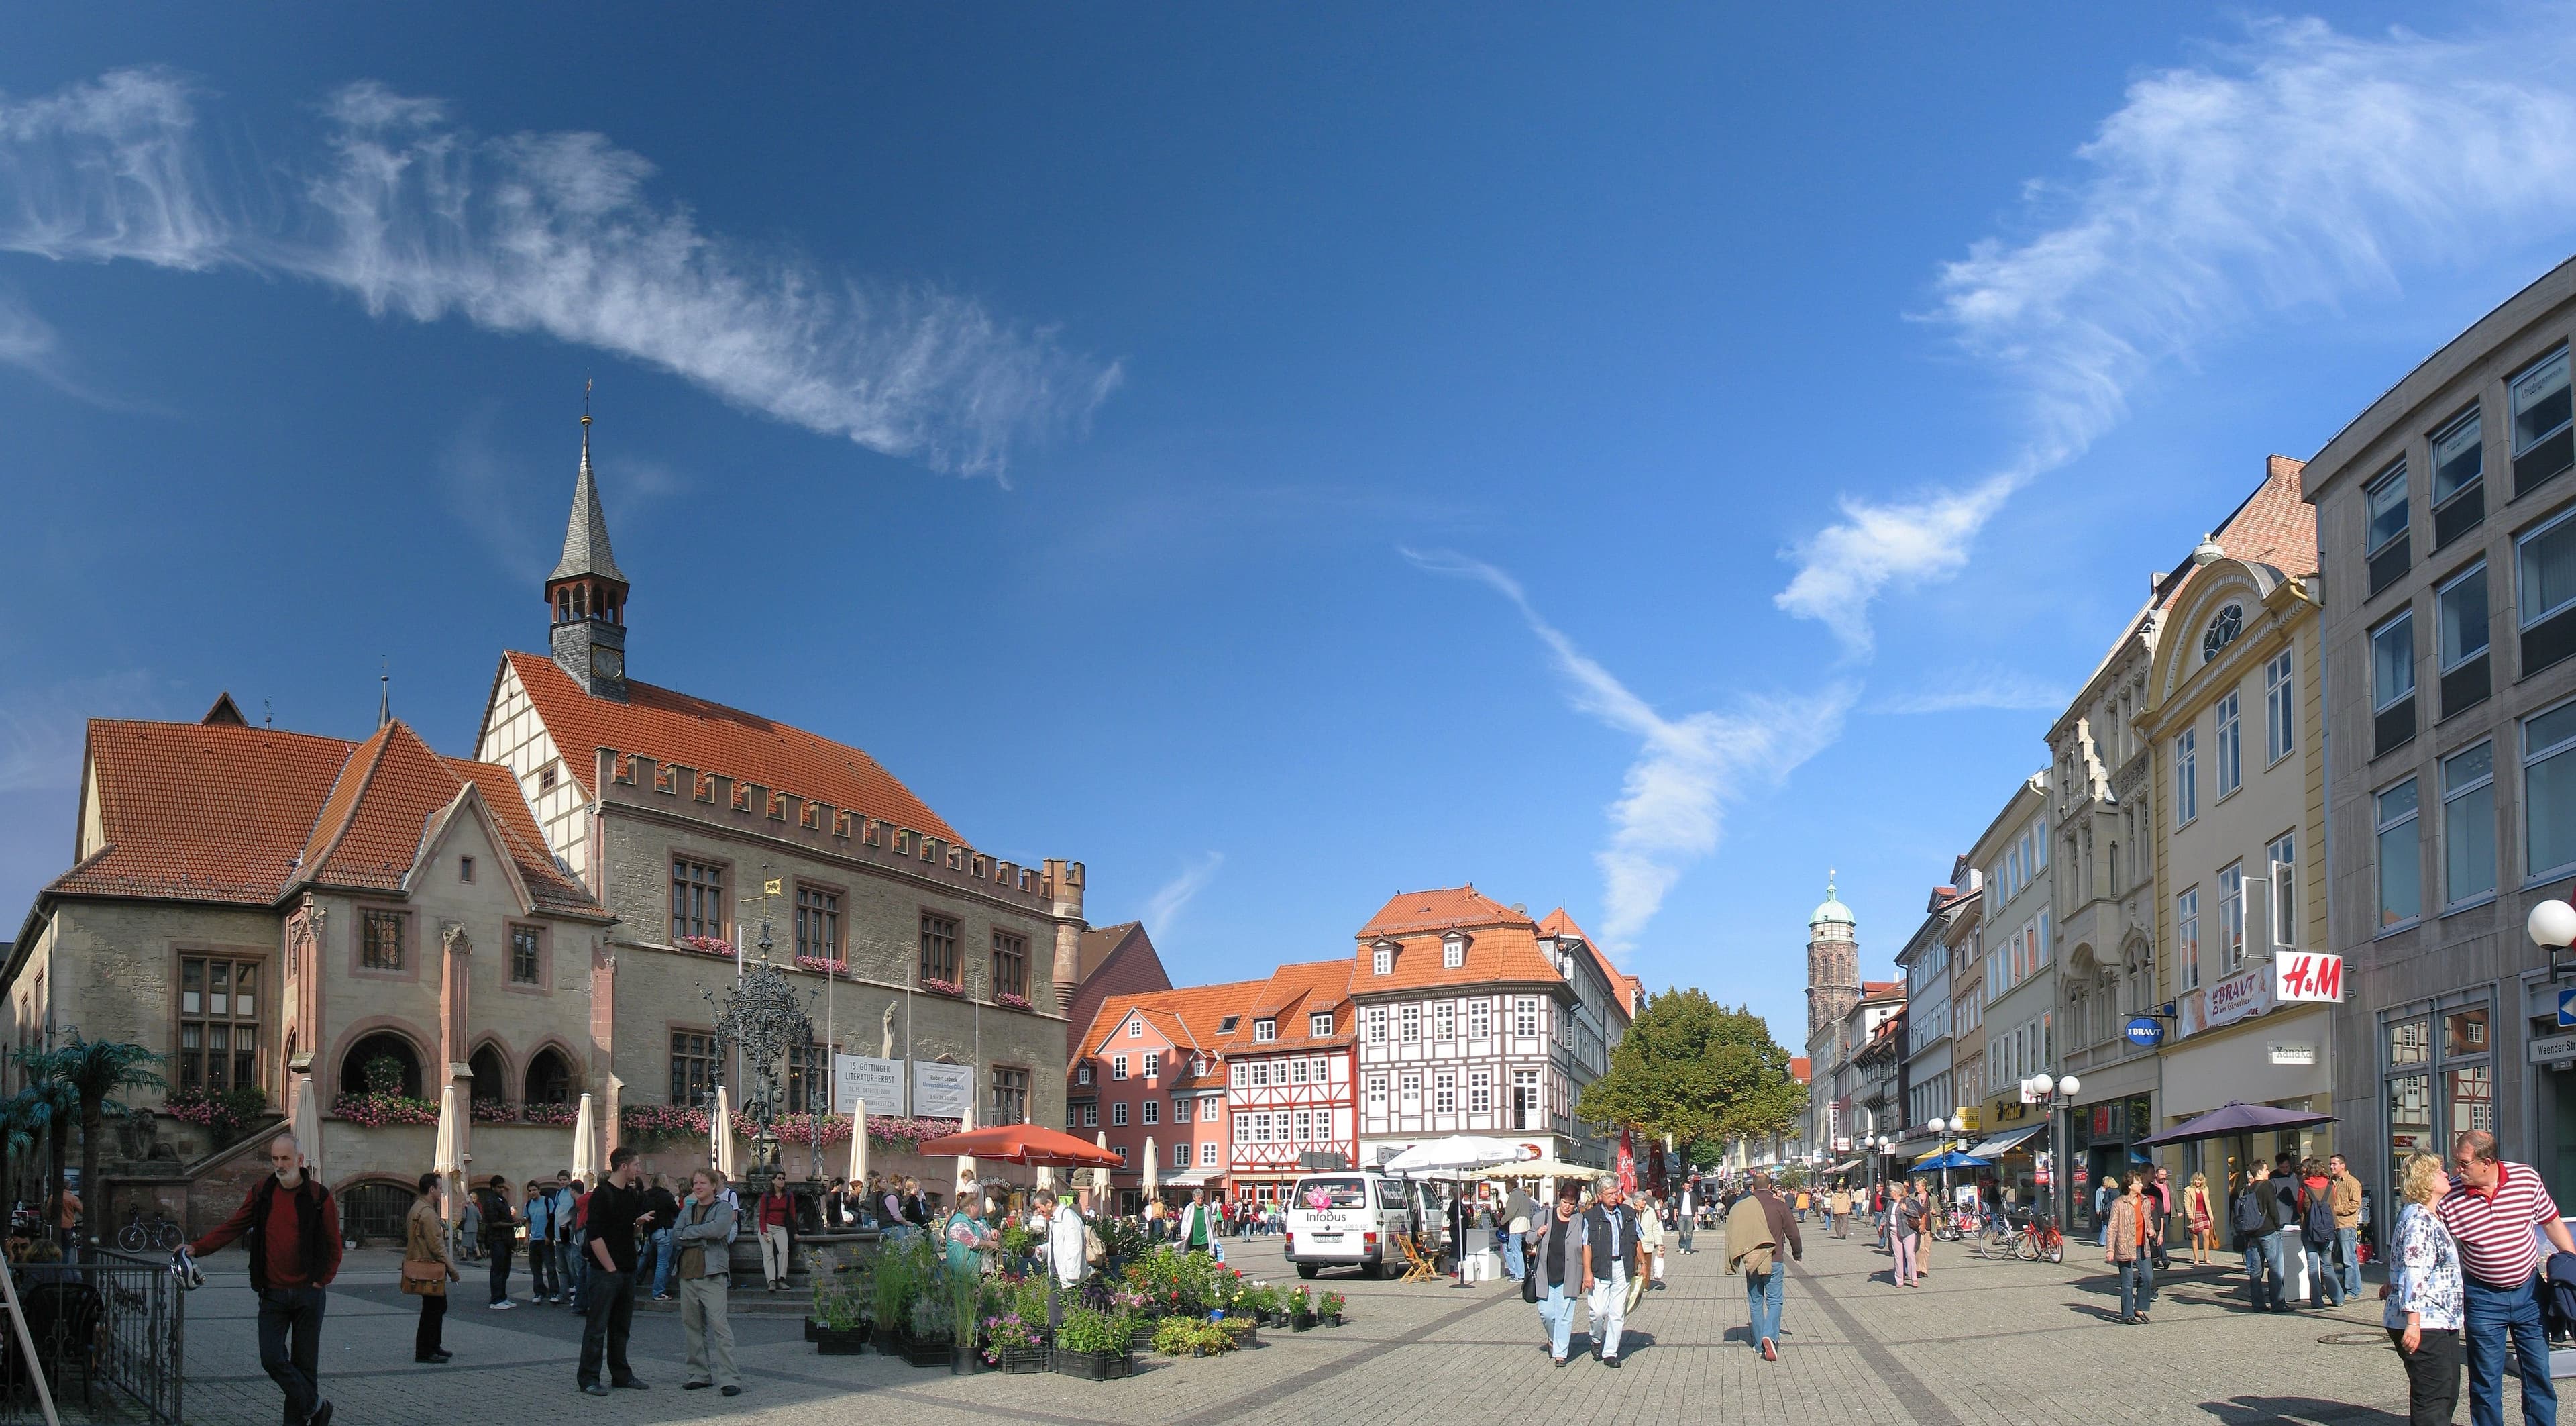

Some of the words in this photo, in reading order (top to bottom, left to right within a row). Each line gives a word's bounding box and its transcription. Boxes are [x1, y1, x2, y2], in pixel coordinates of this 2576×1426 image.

[2282, 956, 2341, 999] H&M
[2218, 974, 2255, 1005] BRAUT
[2276, 1046, 2312, 1058] Xanaka
[2538, 1042, 2565, 1056] Weender
[849, 1062, 858, 1070] 15.
[859, 1062, 890, 1073] GÖTTINGER
[845, 1072, 894, 1084] LITERATURHERBST
[1383, 1188, 1403, 1199] Infobus
[1307, 1212, 1346, 1222] Infobus
